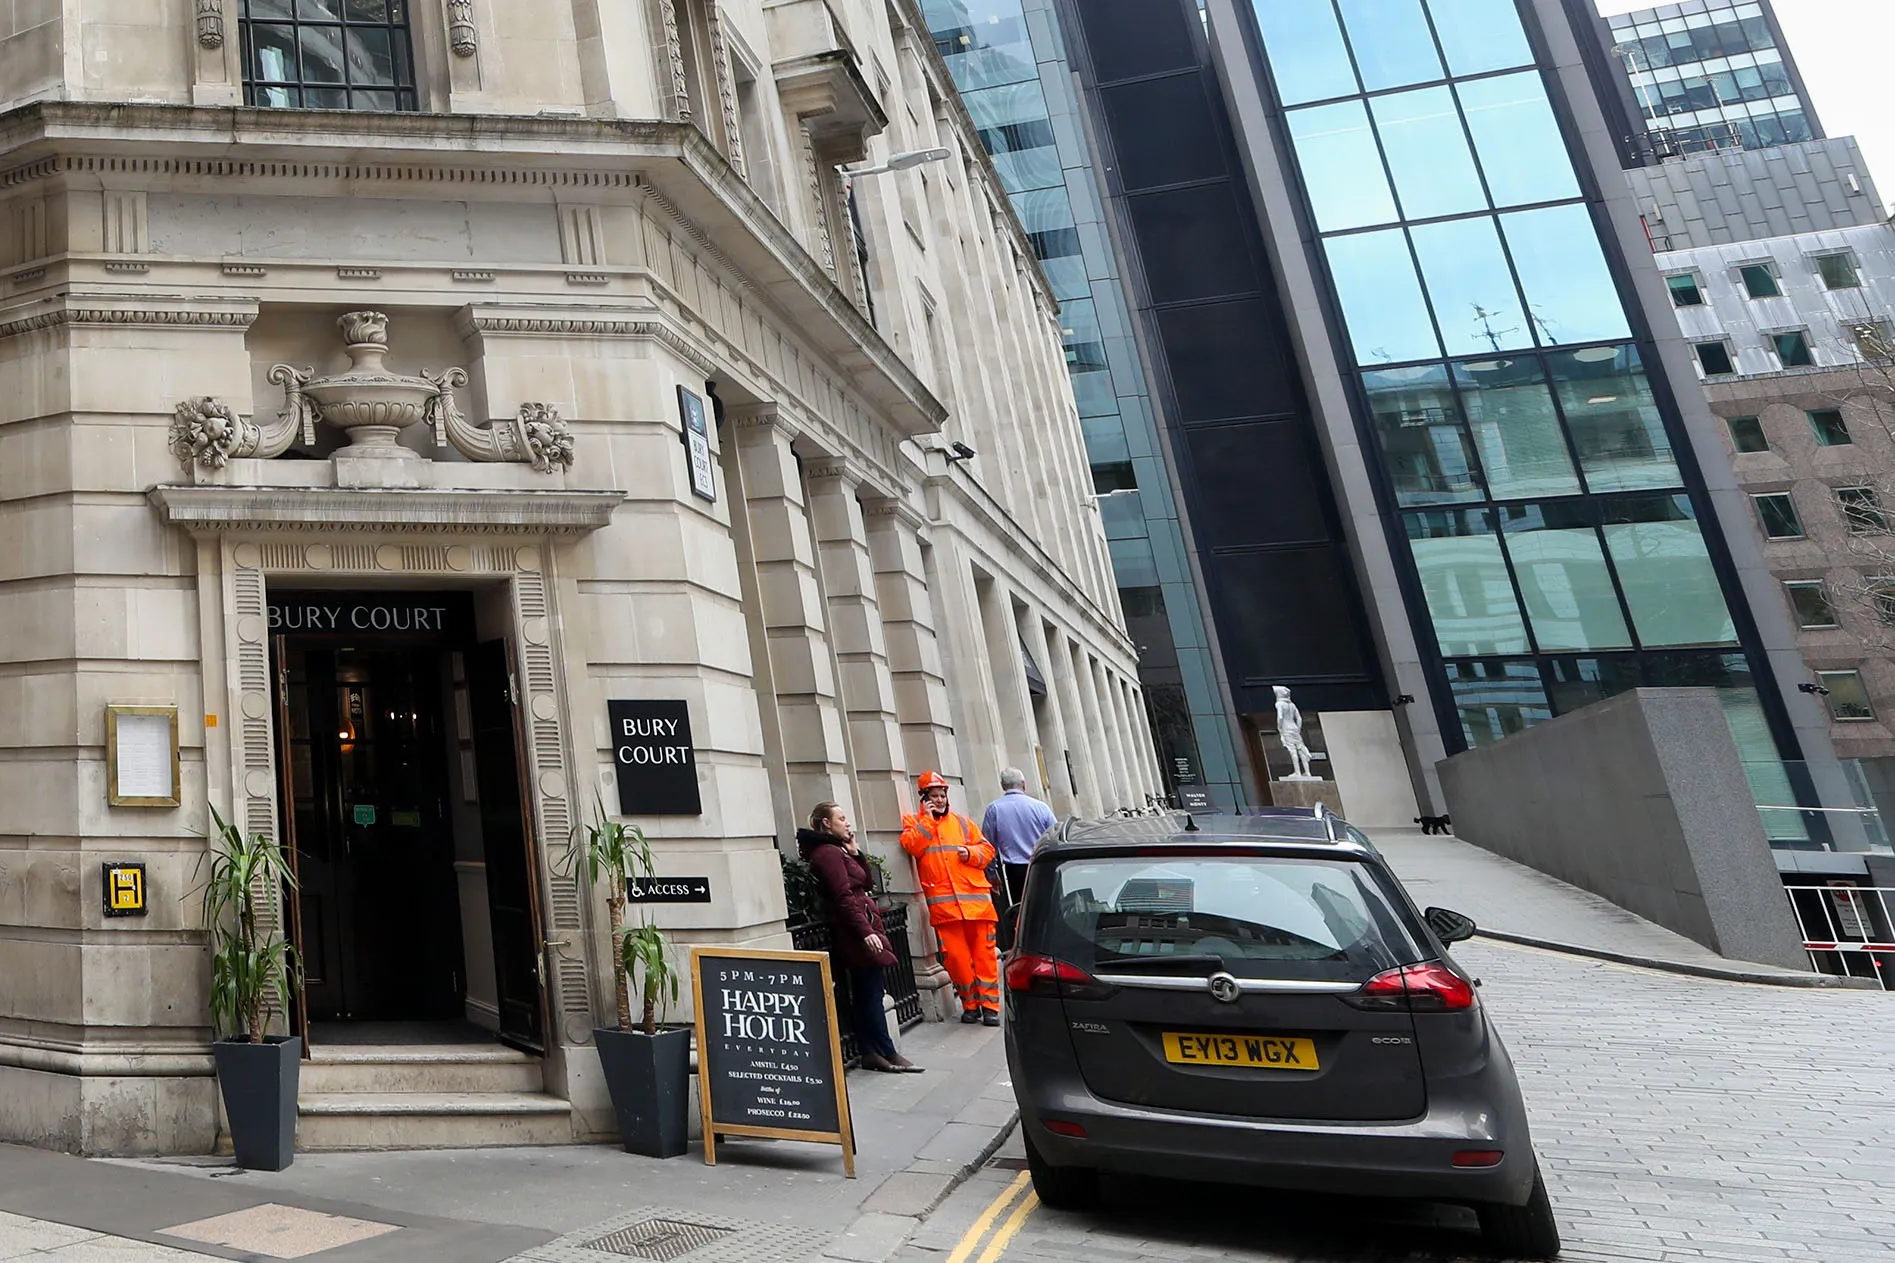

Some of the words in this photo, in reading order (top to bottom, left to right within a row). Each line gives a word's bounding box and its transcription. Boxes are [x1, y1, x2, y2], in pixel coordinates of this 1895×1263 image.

[267, 605, 341, 629] BURY
[351, 605, 447, 630] COURT
[622, 718, 679, 737] BURY
[618, 745, 690, 764] COURT
[647, 884, 690, 896] ACCESS
[721, 988, 805, 1017] HAPPY
[722, 1012, 810, 1045] HOUR
[724, 1043, 810, 1058] EVERYDAY
[1179, 1036, 1239, 1060] EY13
[1246, 1039, 1302, 1065] WGX
[750, 1060, 778, 1069] AMSTEL
[728, 1071, 763, 1080] SELECTED
[764, 1073, 802, 1083] COCKTAILS
[757, 1096, 777, 1105] WINE
[747, 1108, 785, 1118] PROSECCO
